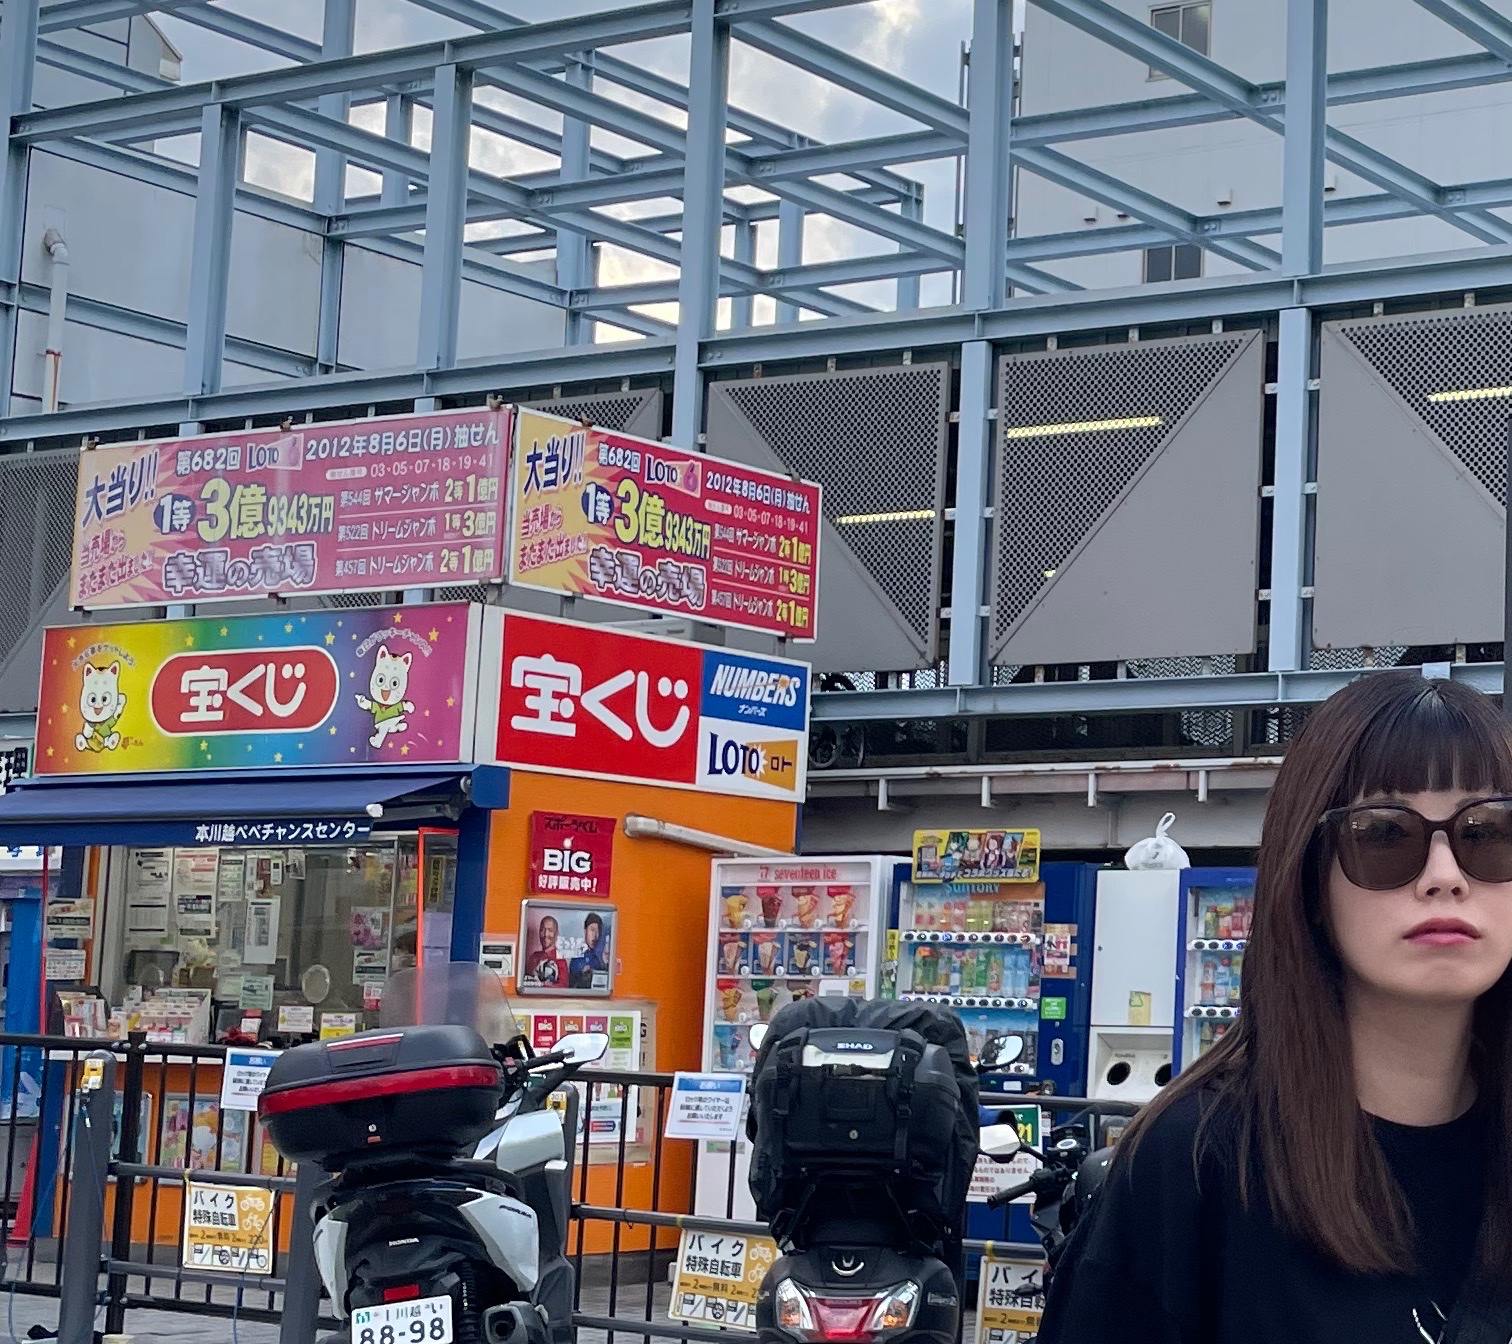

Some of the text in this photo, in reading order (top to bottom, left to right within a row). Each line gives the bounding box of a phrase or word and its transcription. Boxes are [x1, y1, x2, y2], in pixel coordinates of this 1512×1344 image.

[177, 446, 241, 476] 第682回
[598, 442, 641, 473] 第682回
[646, 455, 678, 483] LOTO
[160, 495, 191, 533] 1等
[585, 483, 611, 525] 1等
[164, 544, 316, 595] 幸運の売場
[589, 547, 705, 608] 幸運の売場
[180, 663, 307, 722] 宝くじ
[510, 653, 690, 748] 宝くじ
[709, 664, 800, 707] NUMBERS
[708, 732, 760, 775] LOTO
[195, 822, 371, 844] 本川越ペペチャンスセンター
[543, 846, 592, 873] BIG
[774, 866, 820, 882] seventeen
[823, 865, 837, 880] ice
[194, 1191, 234, 1209] バイク
[689, 1234, 745, 1257] バイク
[685, 1255, 742, 1279] 特殊自転車
